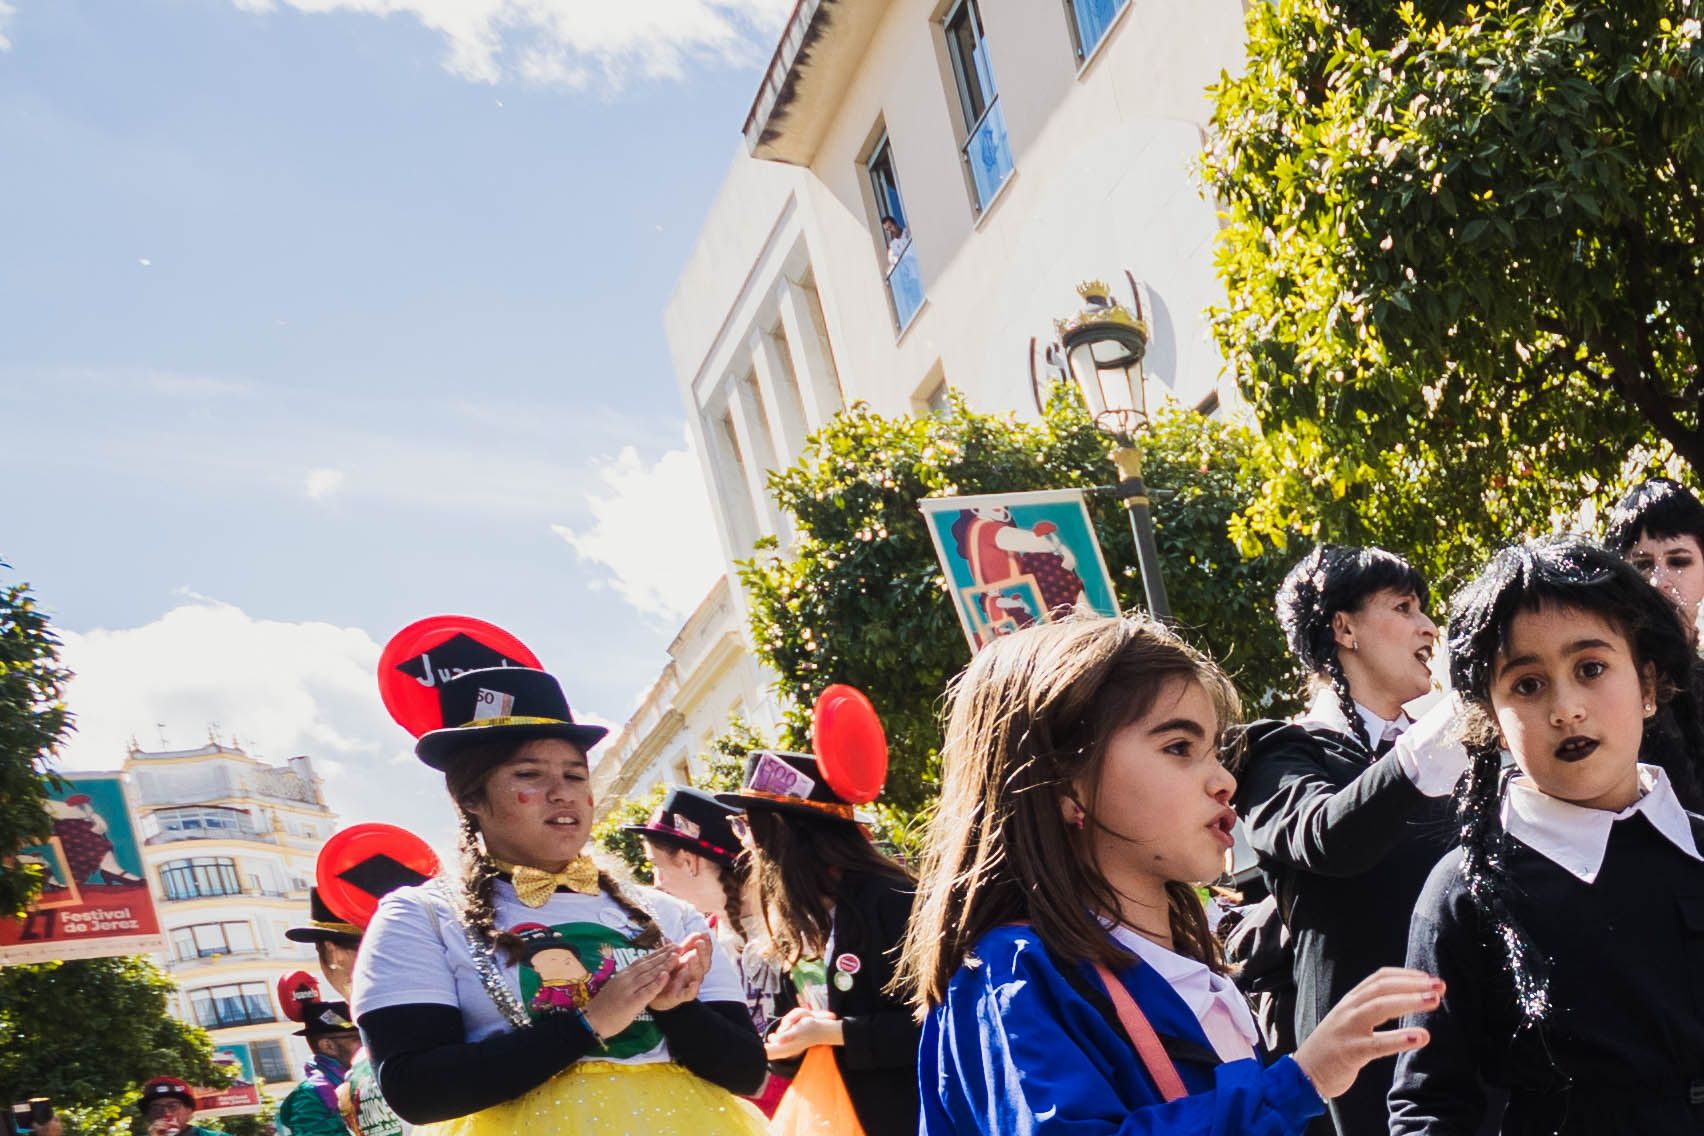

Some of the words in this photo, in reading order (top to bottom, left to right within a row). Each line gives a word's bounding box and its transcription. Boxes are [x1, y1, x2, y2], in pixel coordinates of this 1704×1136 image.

[764, 759, 798, 787] 500
[60, 908, 131, 923] Festival
[64, 921, 88, 933] de
[91, 919, 139, 932] Jerez
